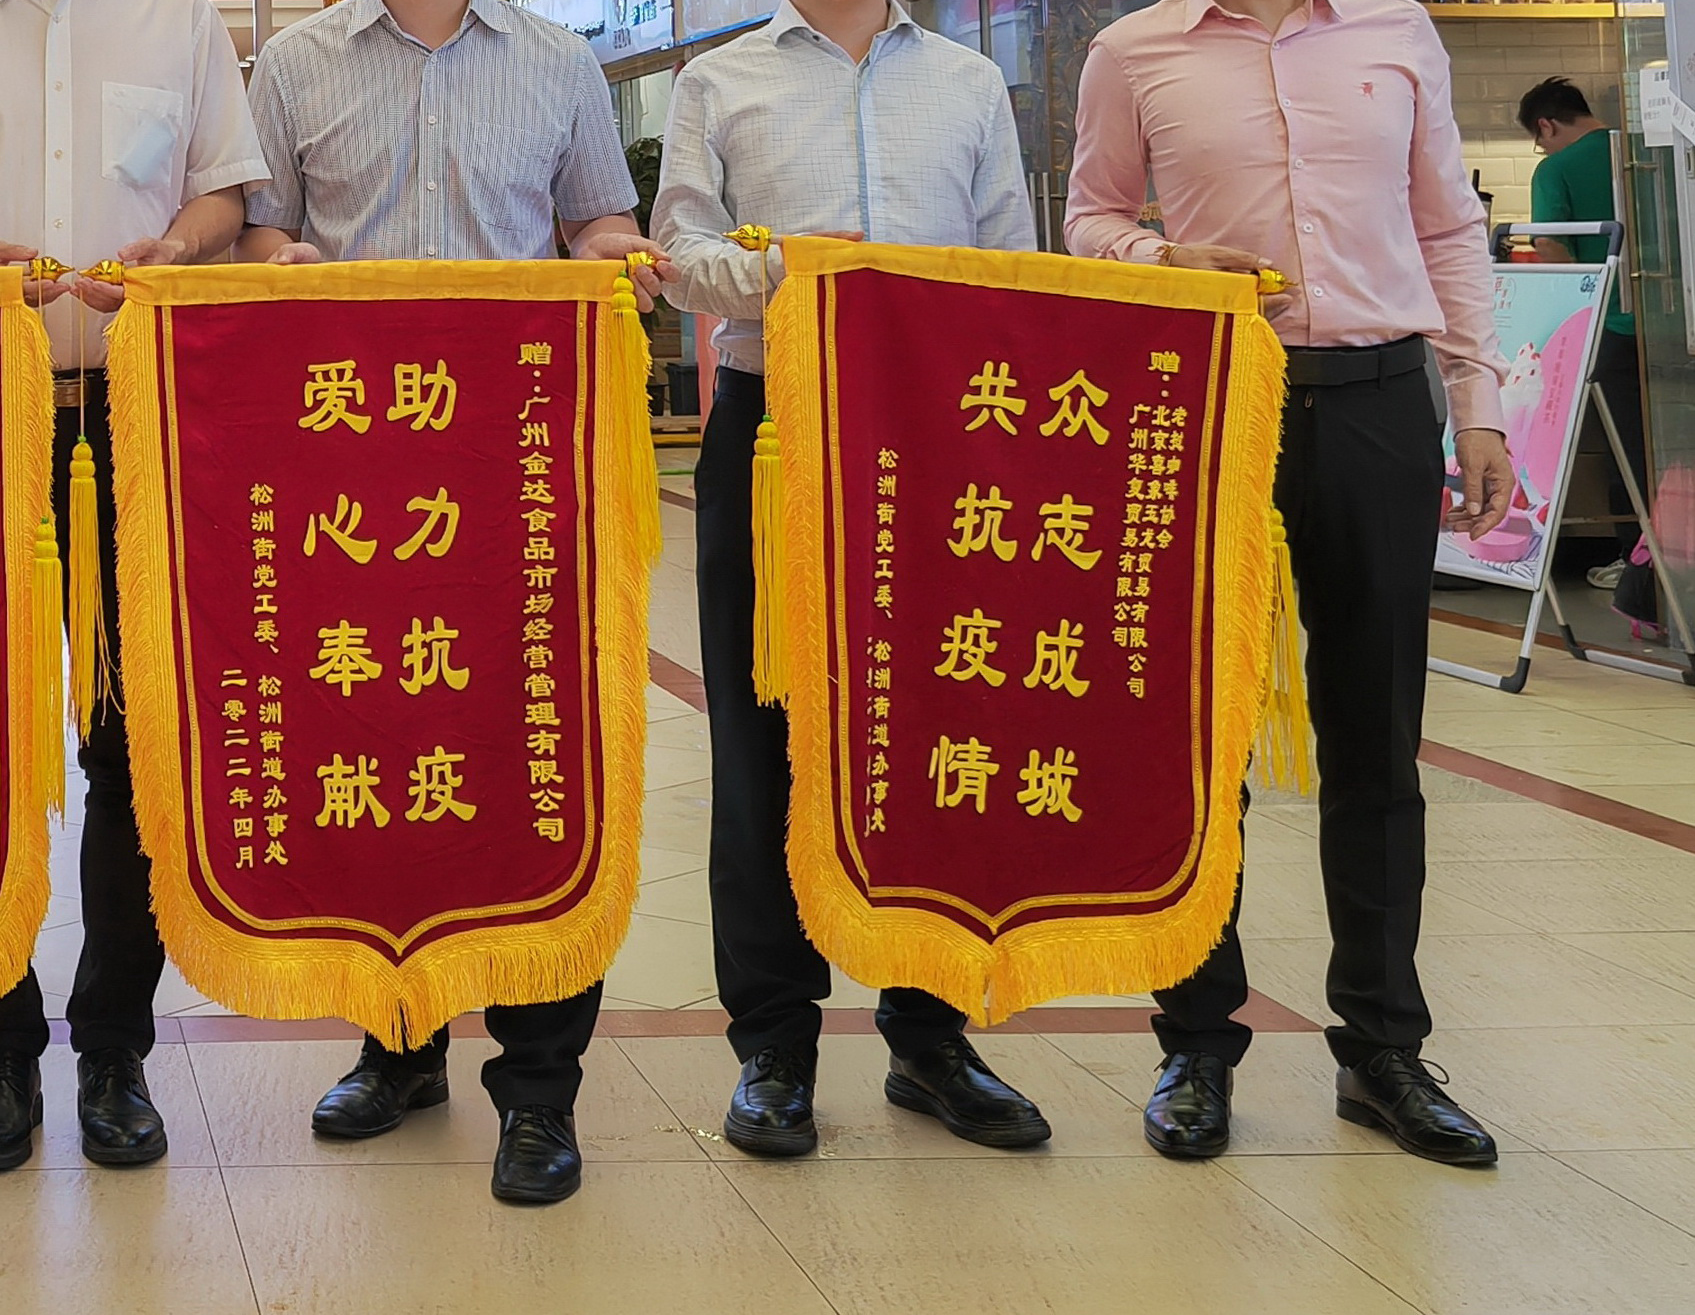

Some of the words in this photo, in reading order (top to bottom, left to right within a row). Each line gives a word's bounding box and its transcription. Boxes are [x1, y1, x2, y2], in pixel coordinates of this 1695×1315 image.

[220, 669, 254, 869] 二零二二年四月
[298, 359, 391, 828] 爱心奉献
[386, 358, 477, 822] 助力抗疫
[928, 360, 1027, 814] 共抗疫情
[1017, 369, 1110, 824] 众志成城
